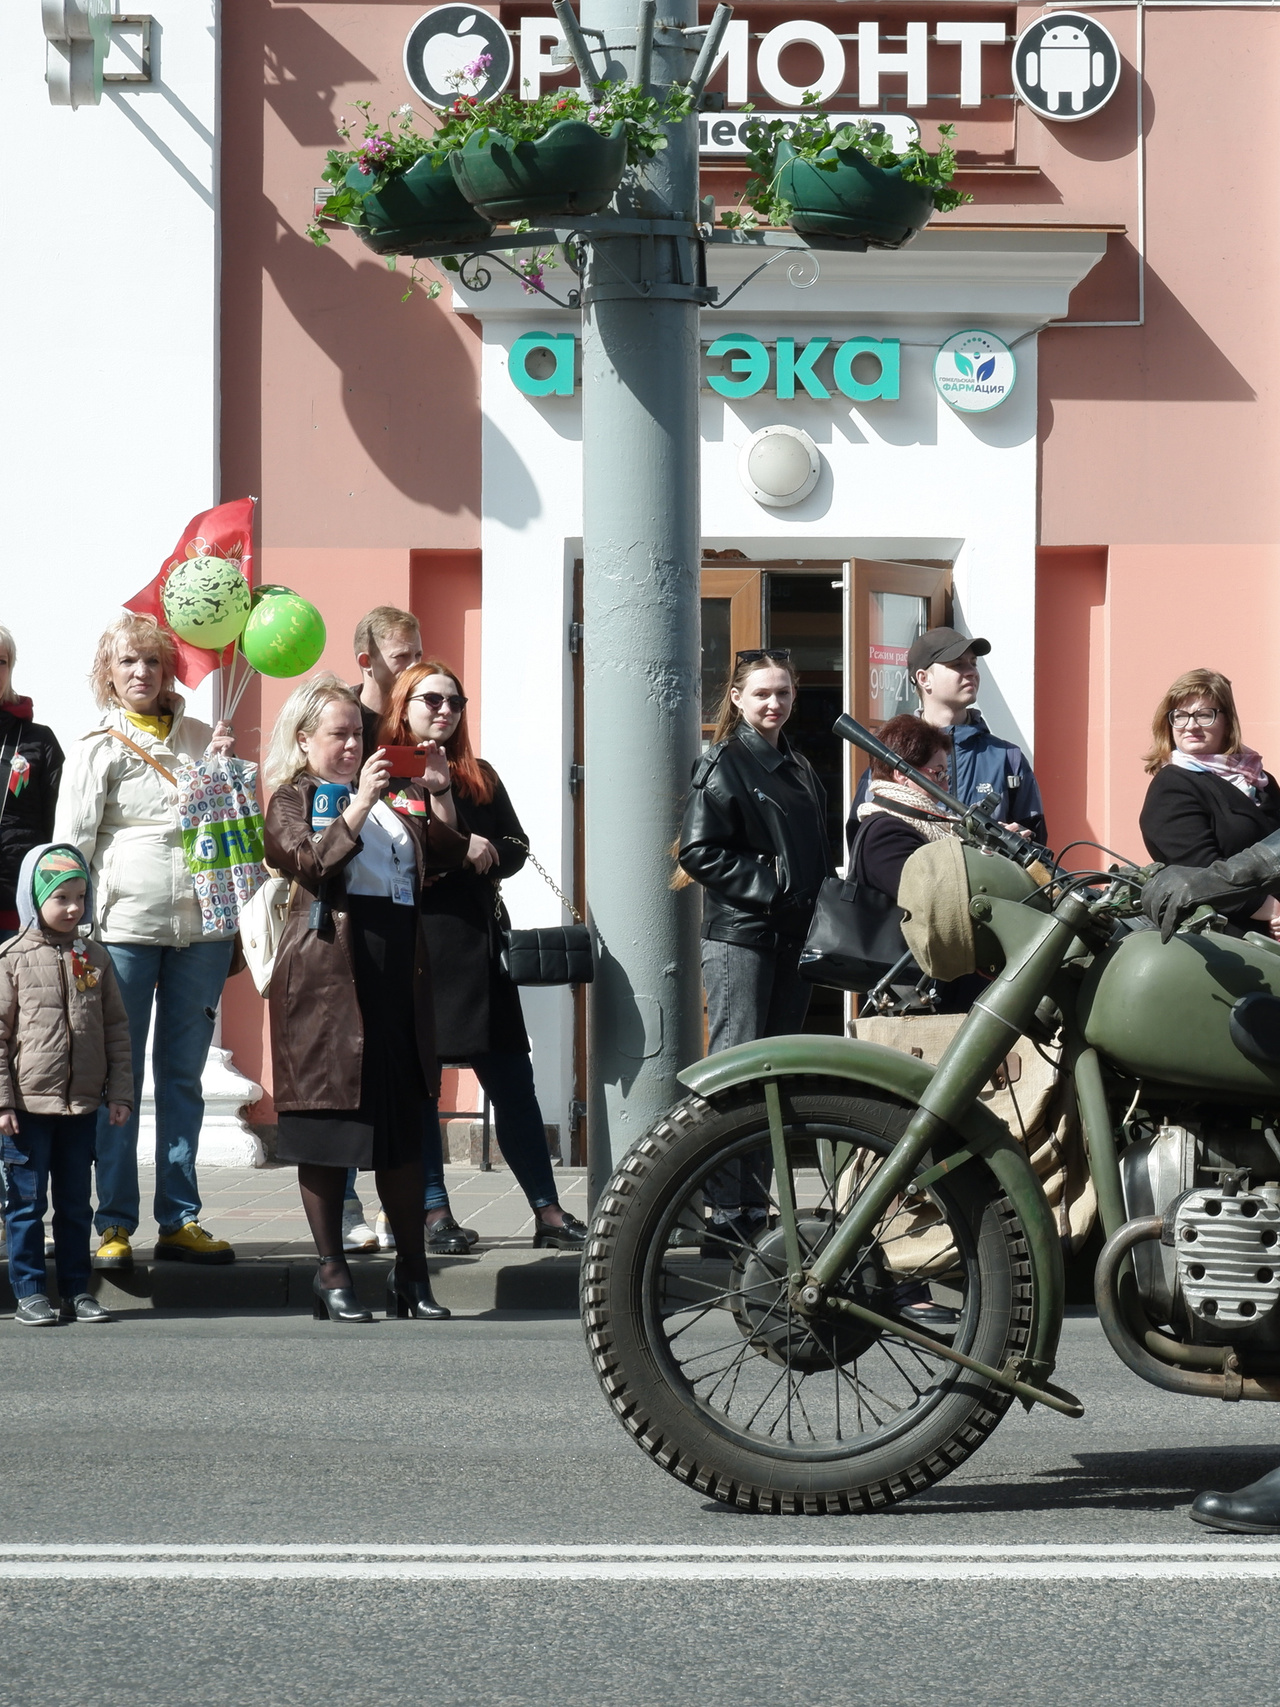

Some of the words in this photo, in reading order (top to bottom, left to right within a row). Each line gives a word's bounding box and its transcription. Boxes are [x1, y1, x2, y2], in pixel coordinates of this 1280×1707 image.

[508, 330, 900, 402] аэка
[943, 383, 1005, 394] ФАРМАЦИЯ
[869, 646, 895, 661] Режим
